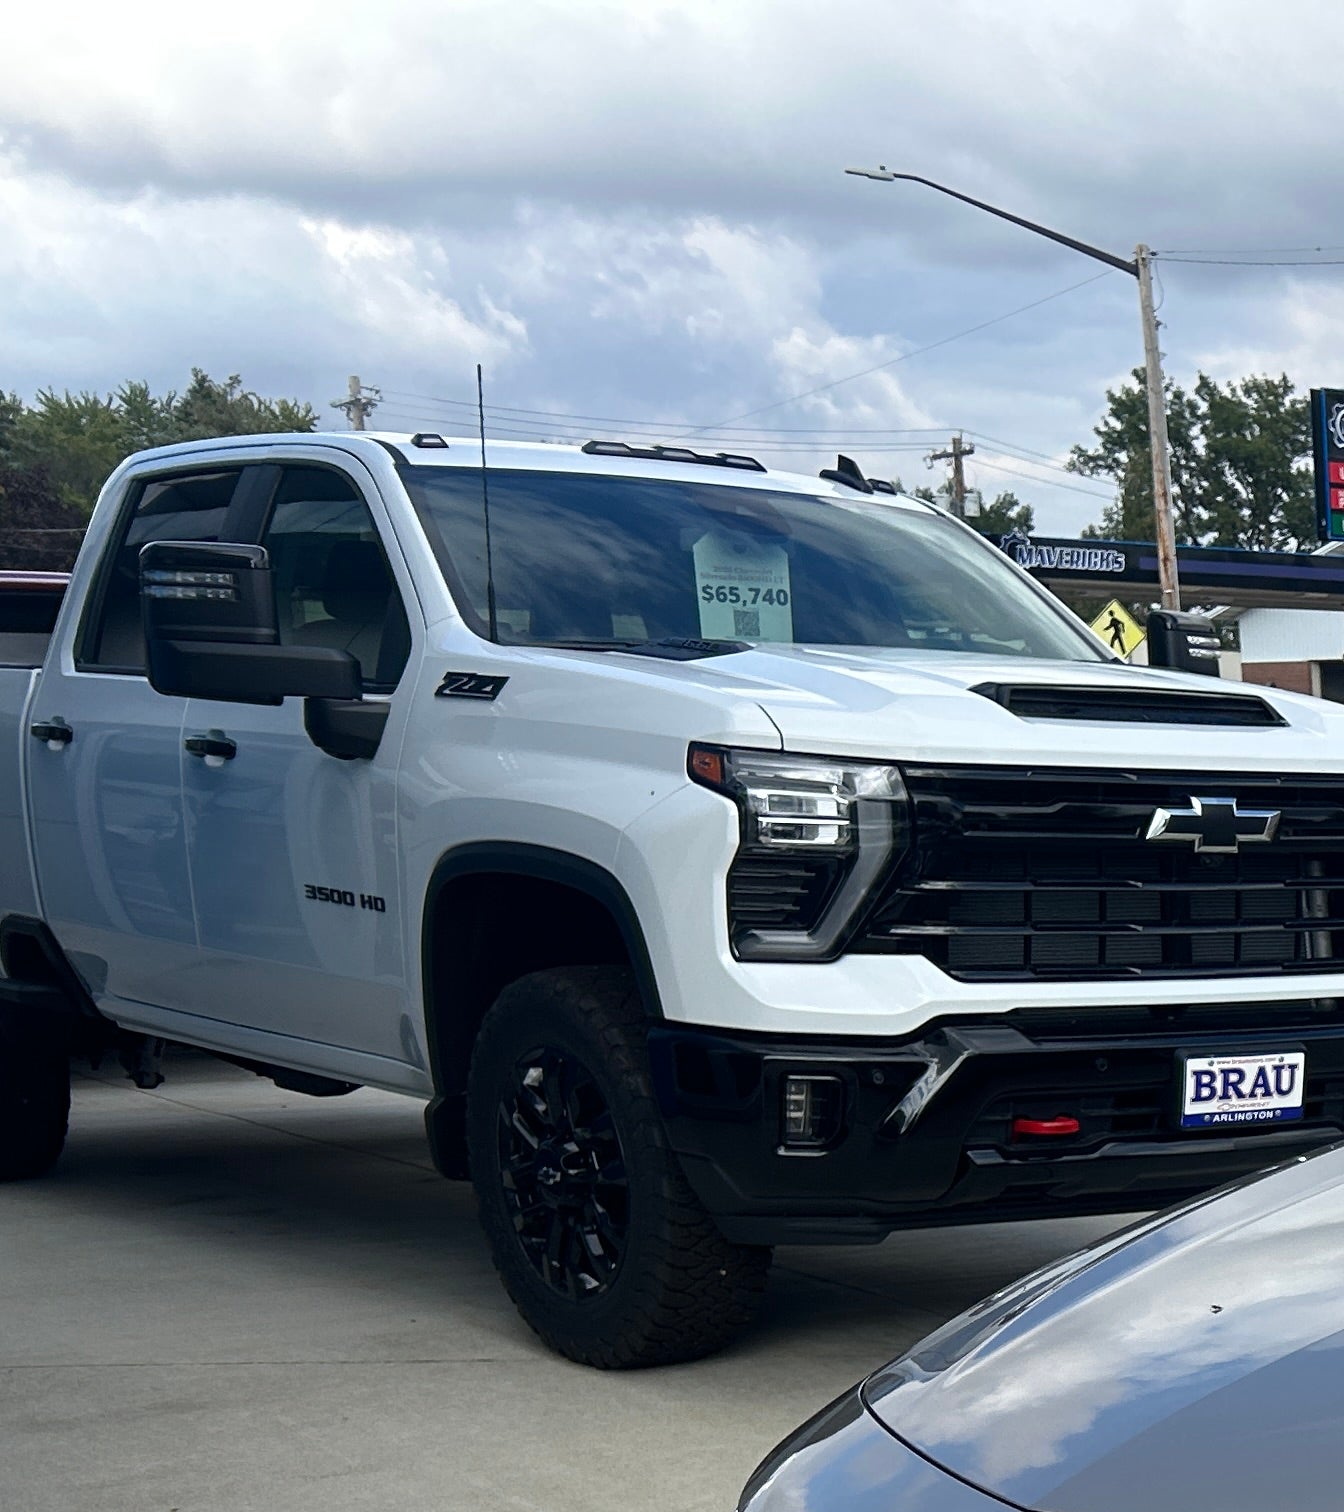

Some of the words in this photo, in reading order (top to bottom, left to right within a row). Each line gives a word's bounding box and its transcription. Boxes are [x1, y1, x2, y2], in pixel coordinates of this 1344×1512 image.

[701, 584, 789, 607] $65,740
[303, 884, 356, 907] 3500
[359, 893, 386, 913] HD
[1190, 1063, 1299, 1104] BRAU
[1212, 1110, 1274, 1123] ARLINGTON
